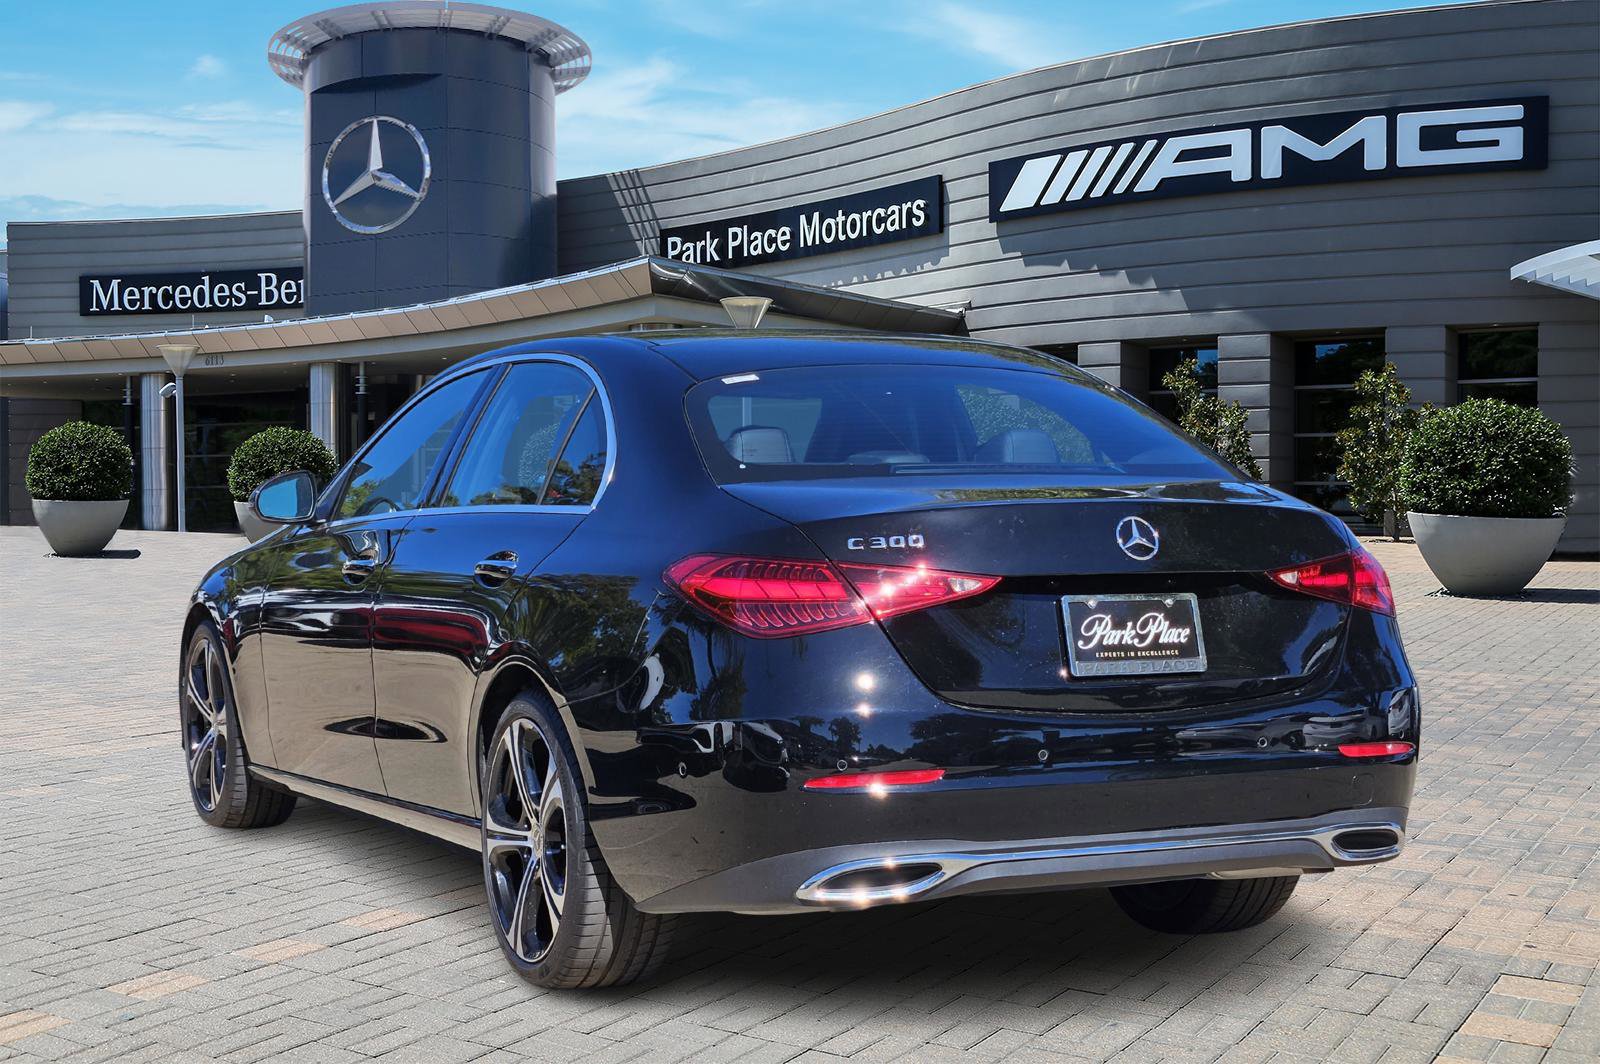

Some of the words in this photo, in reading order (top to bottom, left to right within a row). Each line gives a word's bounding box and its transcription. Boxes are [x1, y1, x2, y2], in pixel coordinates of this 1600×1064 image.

[1133, 104, 1524, 192] AMG
[667, 231, 721, 264] Park
[728, 225, 792, 259] Place
[799, 198, 927, 248] Motorcars
[89, 272, 304, 312] Mercedes-Be
[847, 537, 864, 550] C
[869, 534, 925, 549] 300
[1077, 613, 1136, 650] Park
[1133, 612, 1191, 647] Place
[1081, 661, 1133, 674] PARK
[1139, 659, 1199, 672] PLACE
[1137, 649, 1180, 657] EXCELLENCE
